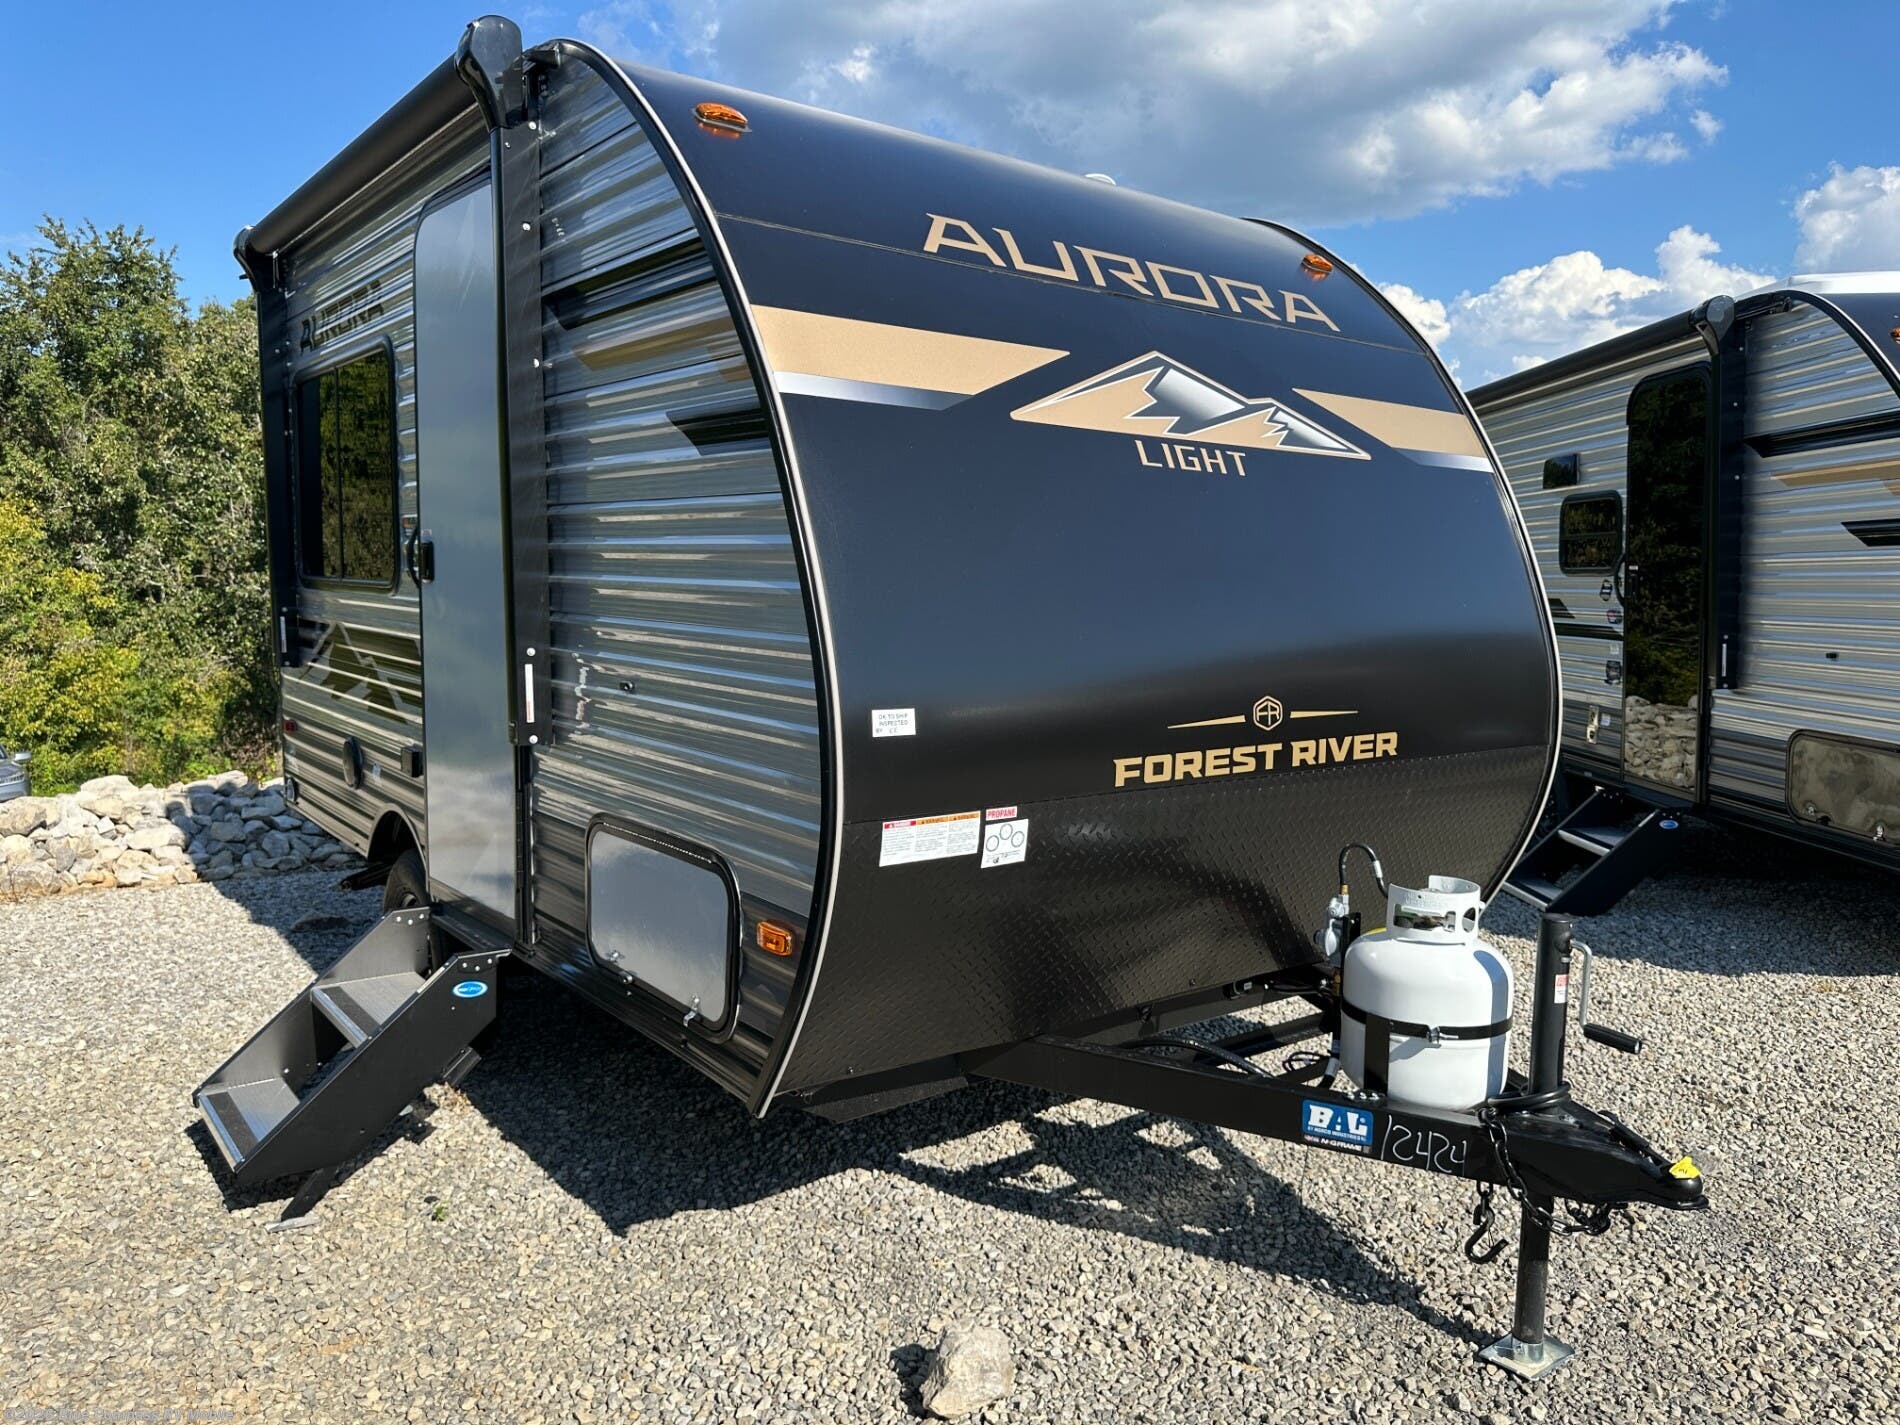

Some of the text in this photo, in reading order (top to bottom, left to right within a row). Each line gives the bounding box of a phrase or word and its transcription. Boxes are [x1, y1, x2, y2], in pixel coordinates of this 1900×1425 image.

[923, 212, 1341, 333] AURORA
[300, 280, 384, 355] AURORA
[1135, 439, 1246, 477] LIGHT
[1113, 731, 1398, 787] FOREST RIVER
[987, 807, 1016, 819] PROPANE
[1380, 1114, 1467, 1176] 12424
